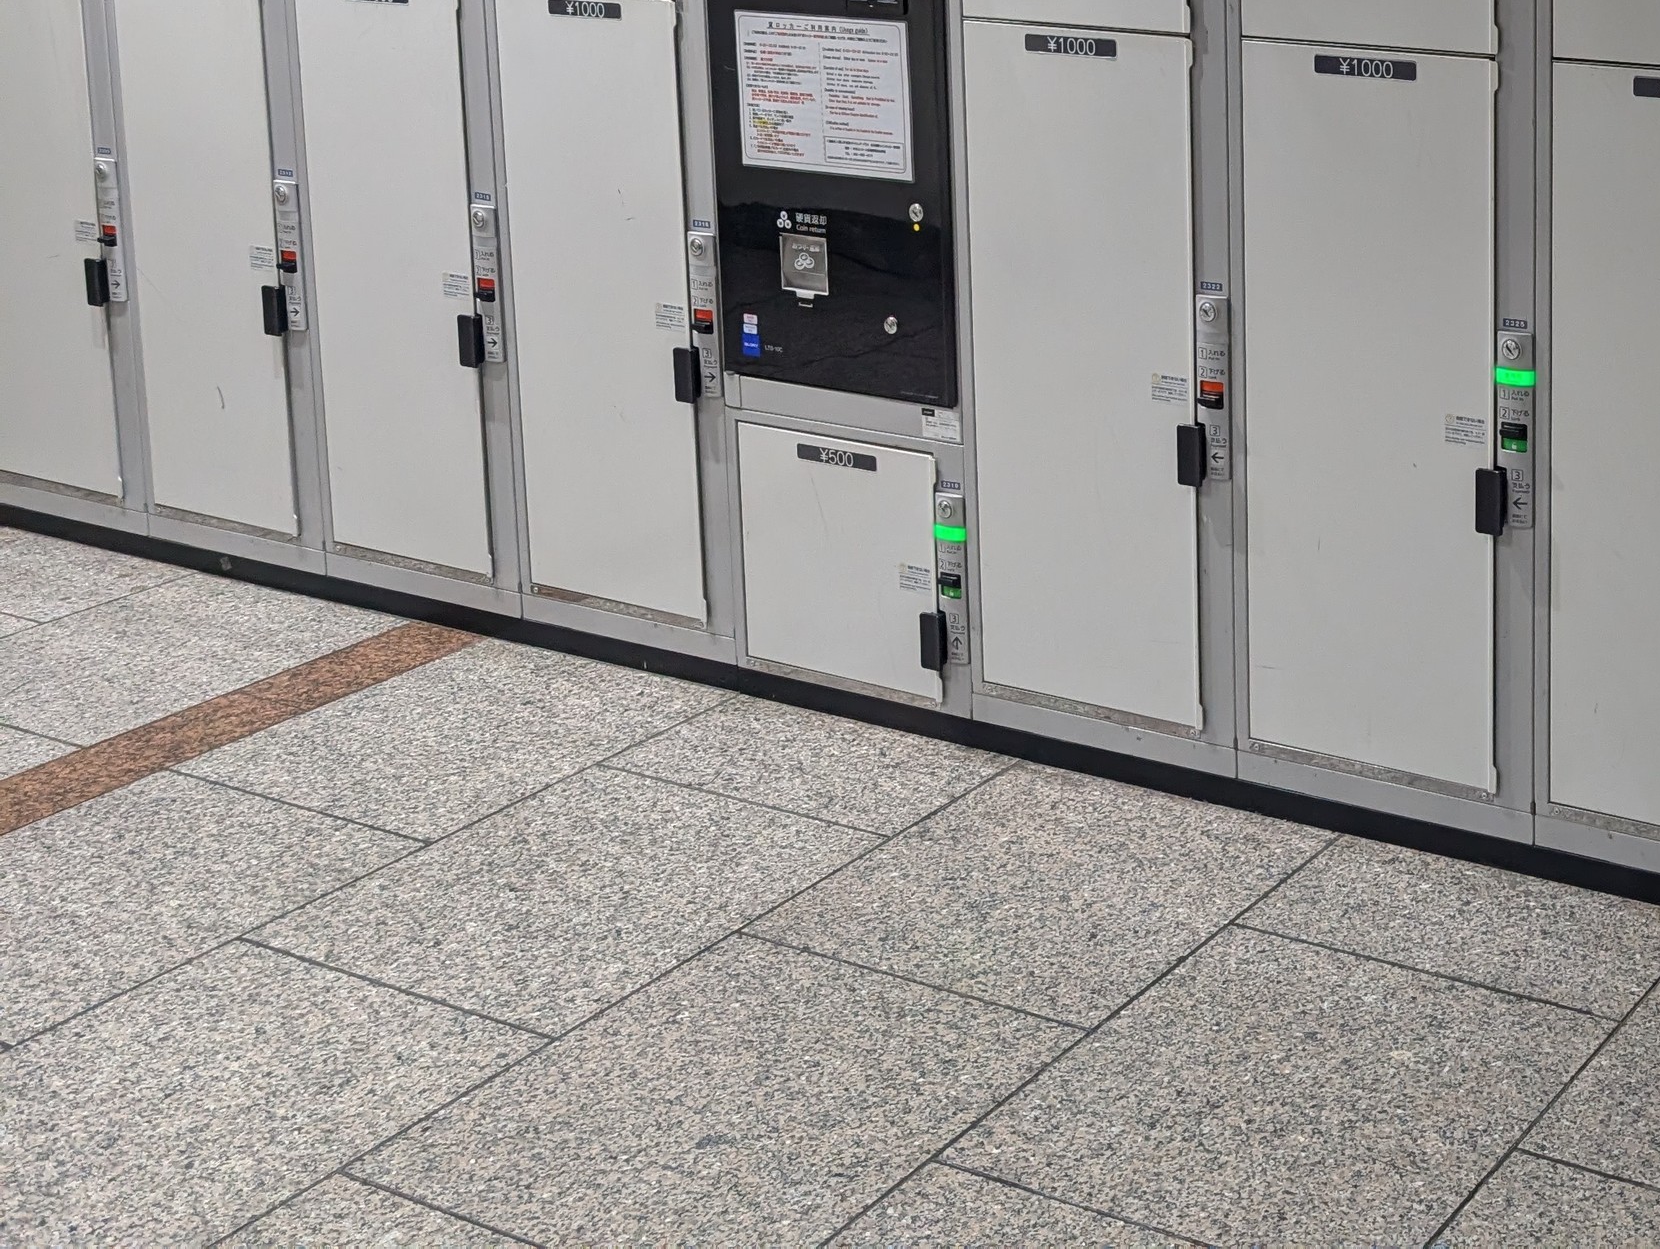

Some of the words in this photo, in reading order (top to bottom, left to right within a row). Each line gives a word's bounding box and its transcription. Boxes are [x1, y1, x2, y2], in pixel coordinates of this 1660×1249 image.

[566, 1, 605, 17] ¥1000
[1047, 37, 1095, 57] ¥1000
[1340, 58, 1393, 79] ¥1000
[795, 213, 827, 225] 硬貨返却
[809, 225, 826, 234] return
[820, 448, 853, 466] ¥500
